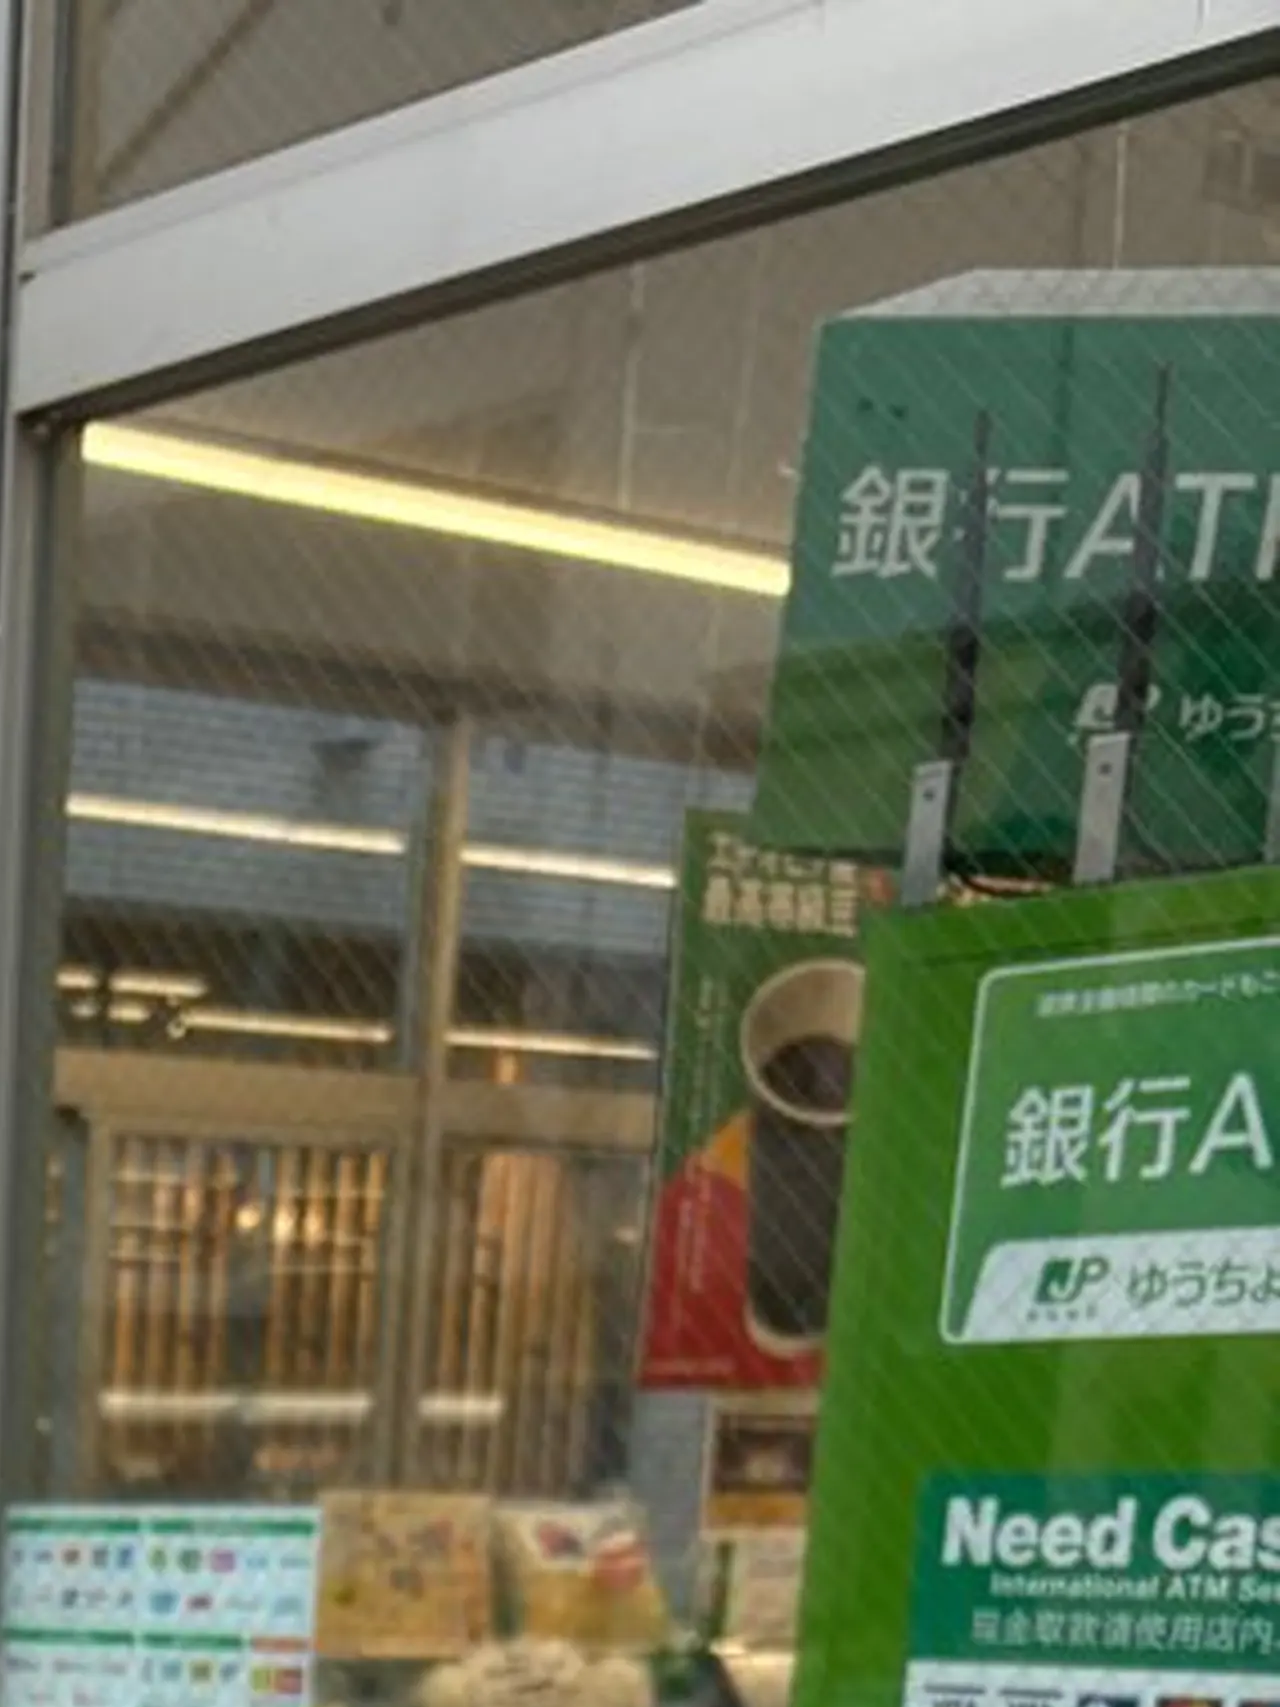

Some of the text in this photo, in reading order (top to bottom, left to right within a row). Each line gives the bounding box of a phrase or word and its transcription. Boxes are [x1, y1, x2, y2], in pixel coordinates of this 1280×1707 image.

[831, 464, 1280, 581] 銀行AT
[942, 1494, 1138, 1567] Need
[1164, 1574, 1229, 1600] ATM
